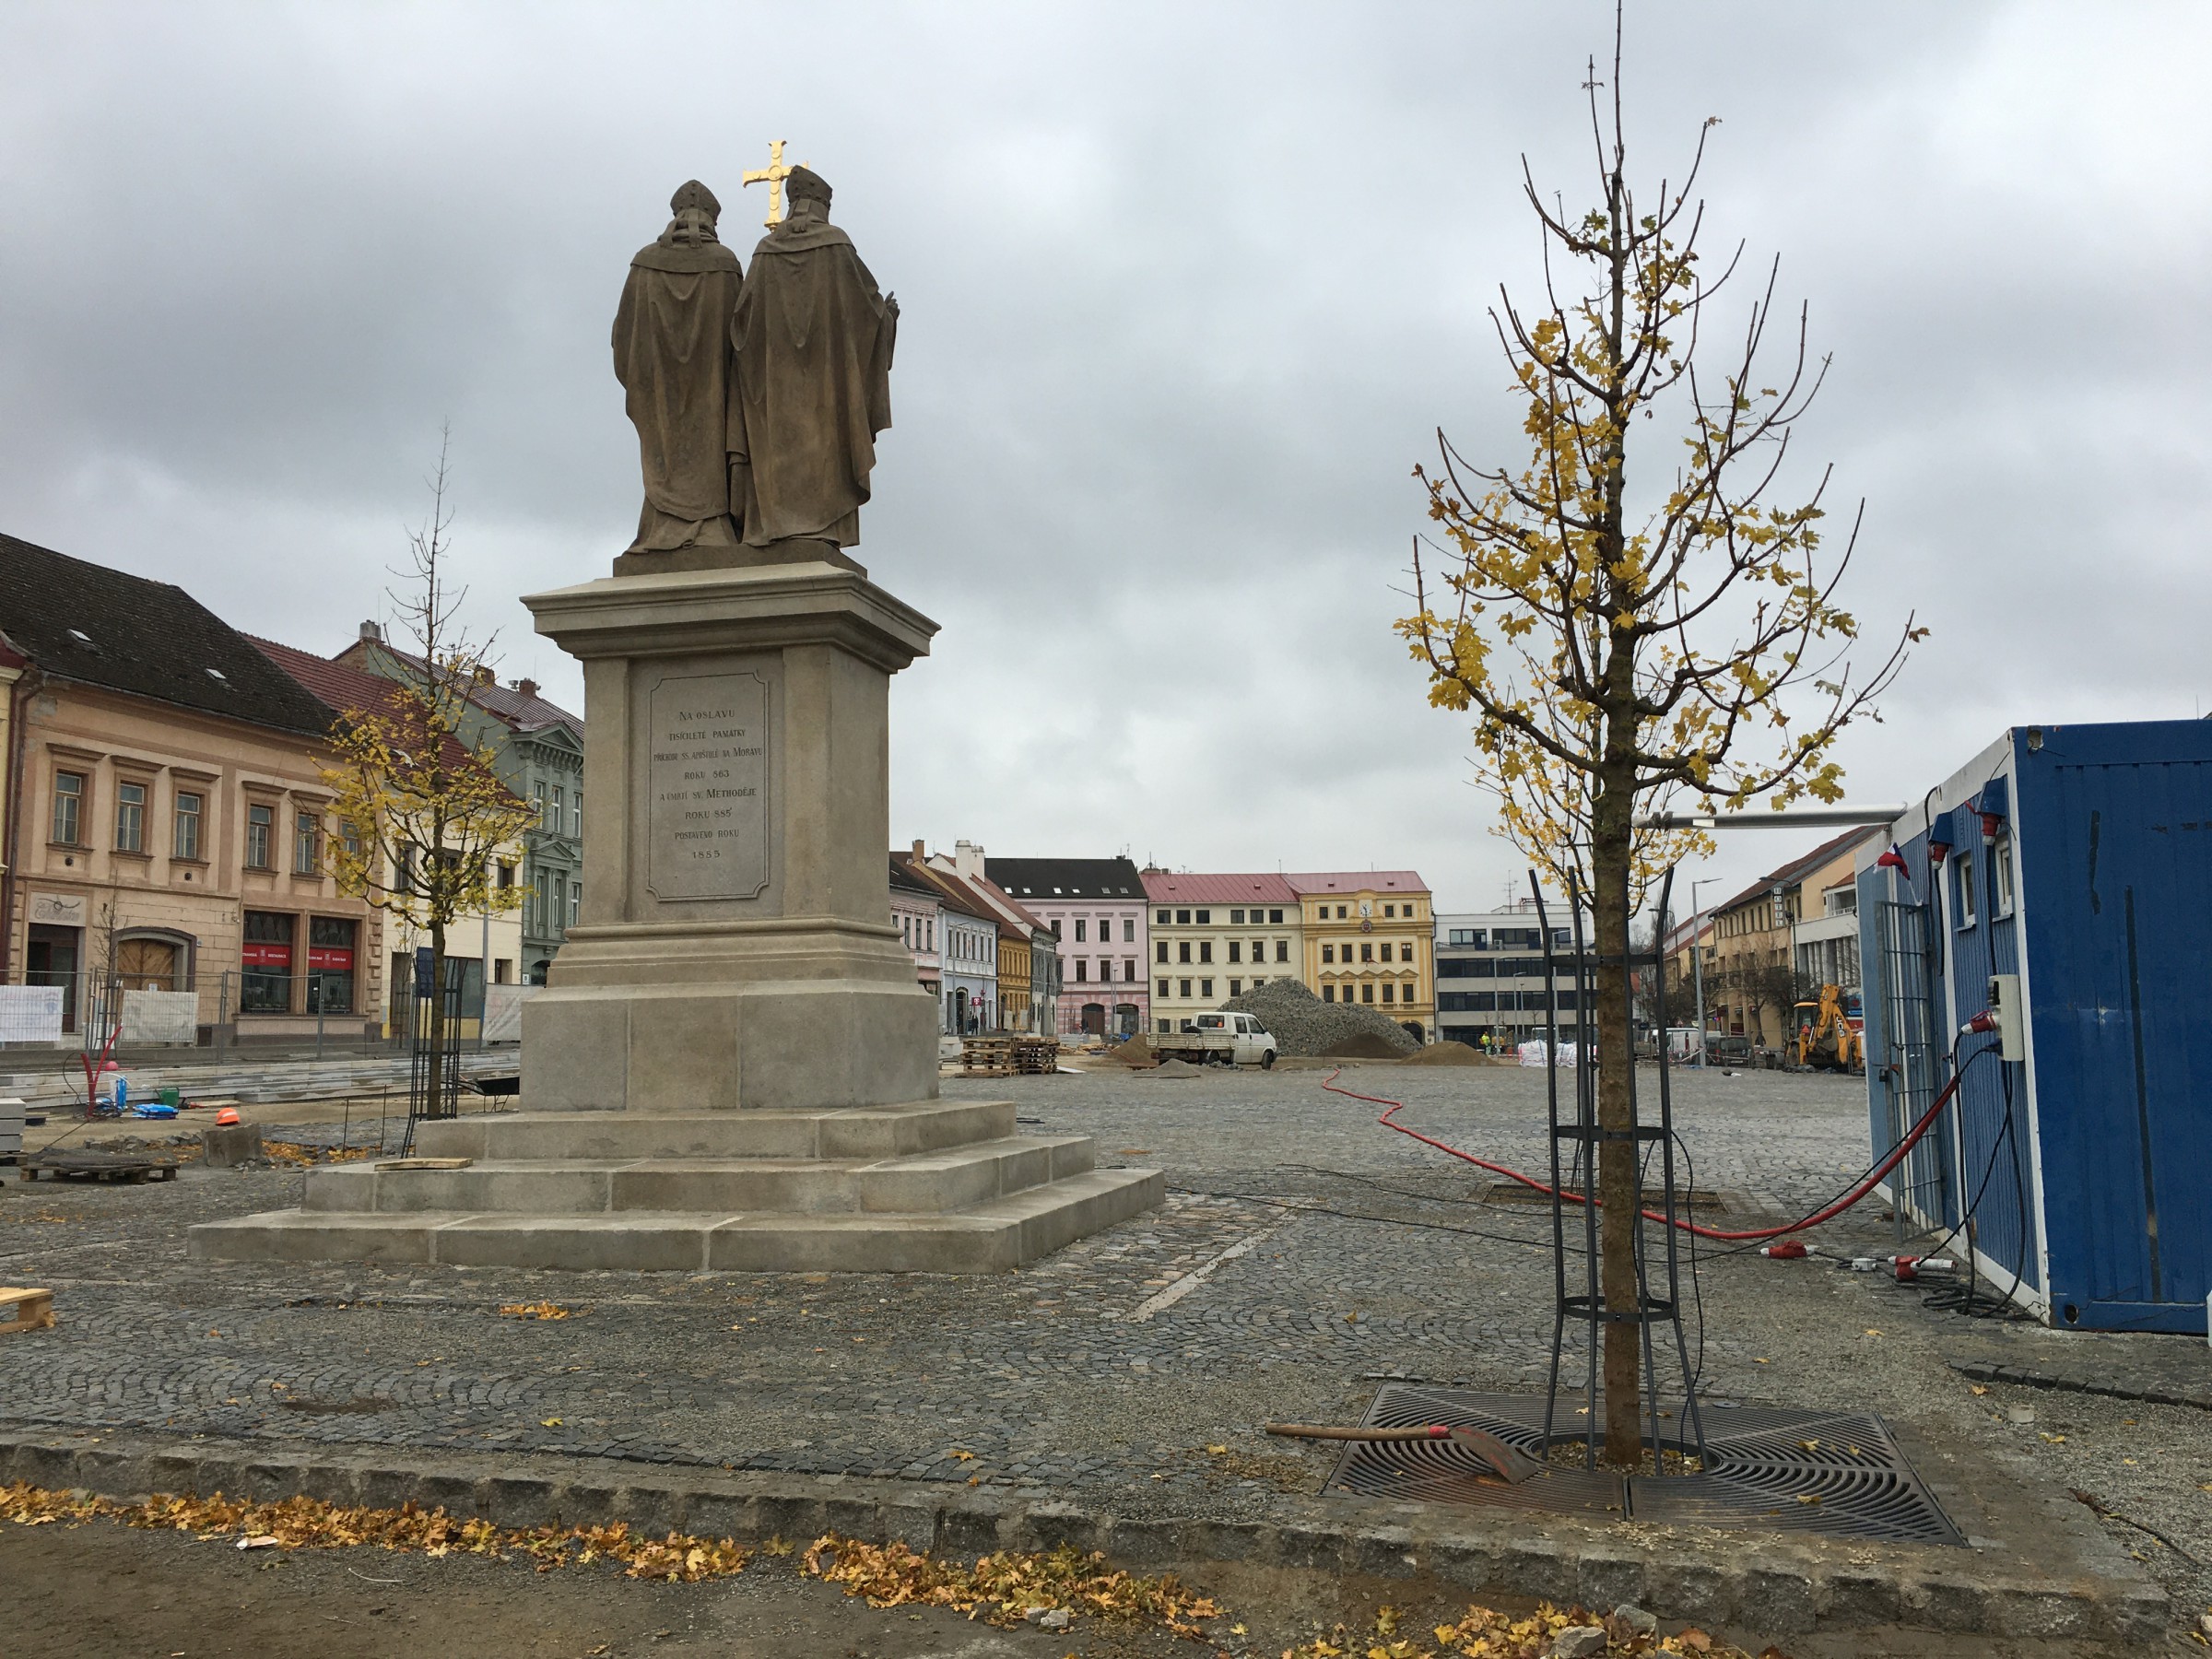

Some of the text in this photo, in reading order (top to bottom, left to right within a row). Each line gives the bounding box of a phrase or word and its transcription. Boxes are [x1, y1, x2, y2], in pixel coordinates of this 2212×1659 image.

[679, 709, 735, 722] NA OSLAVU
[712, 728, 747, 739] PAMÁTKY
[684, 770, 730, 781] ROKU 863
[659, 793, 665, 802] A
[685, 807, 733, 820] ROKU 885
[675, 829, 740, 841] POSTAVENO ROKU
[692, 849, 721, 859] 1885
[1774, 888, 1783, 926] HOTEL
[1836, 1016, 1845, 1038] JCB
